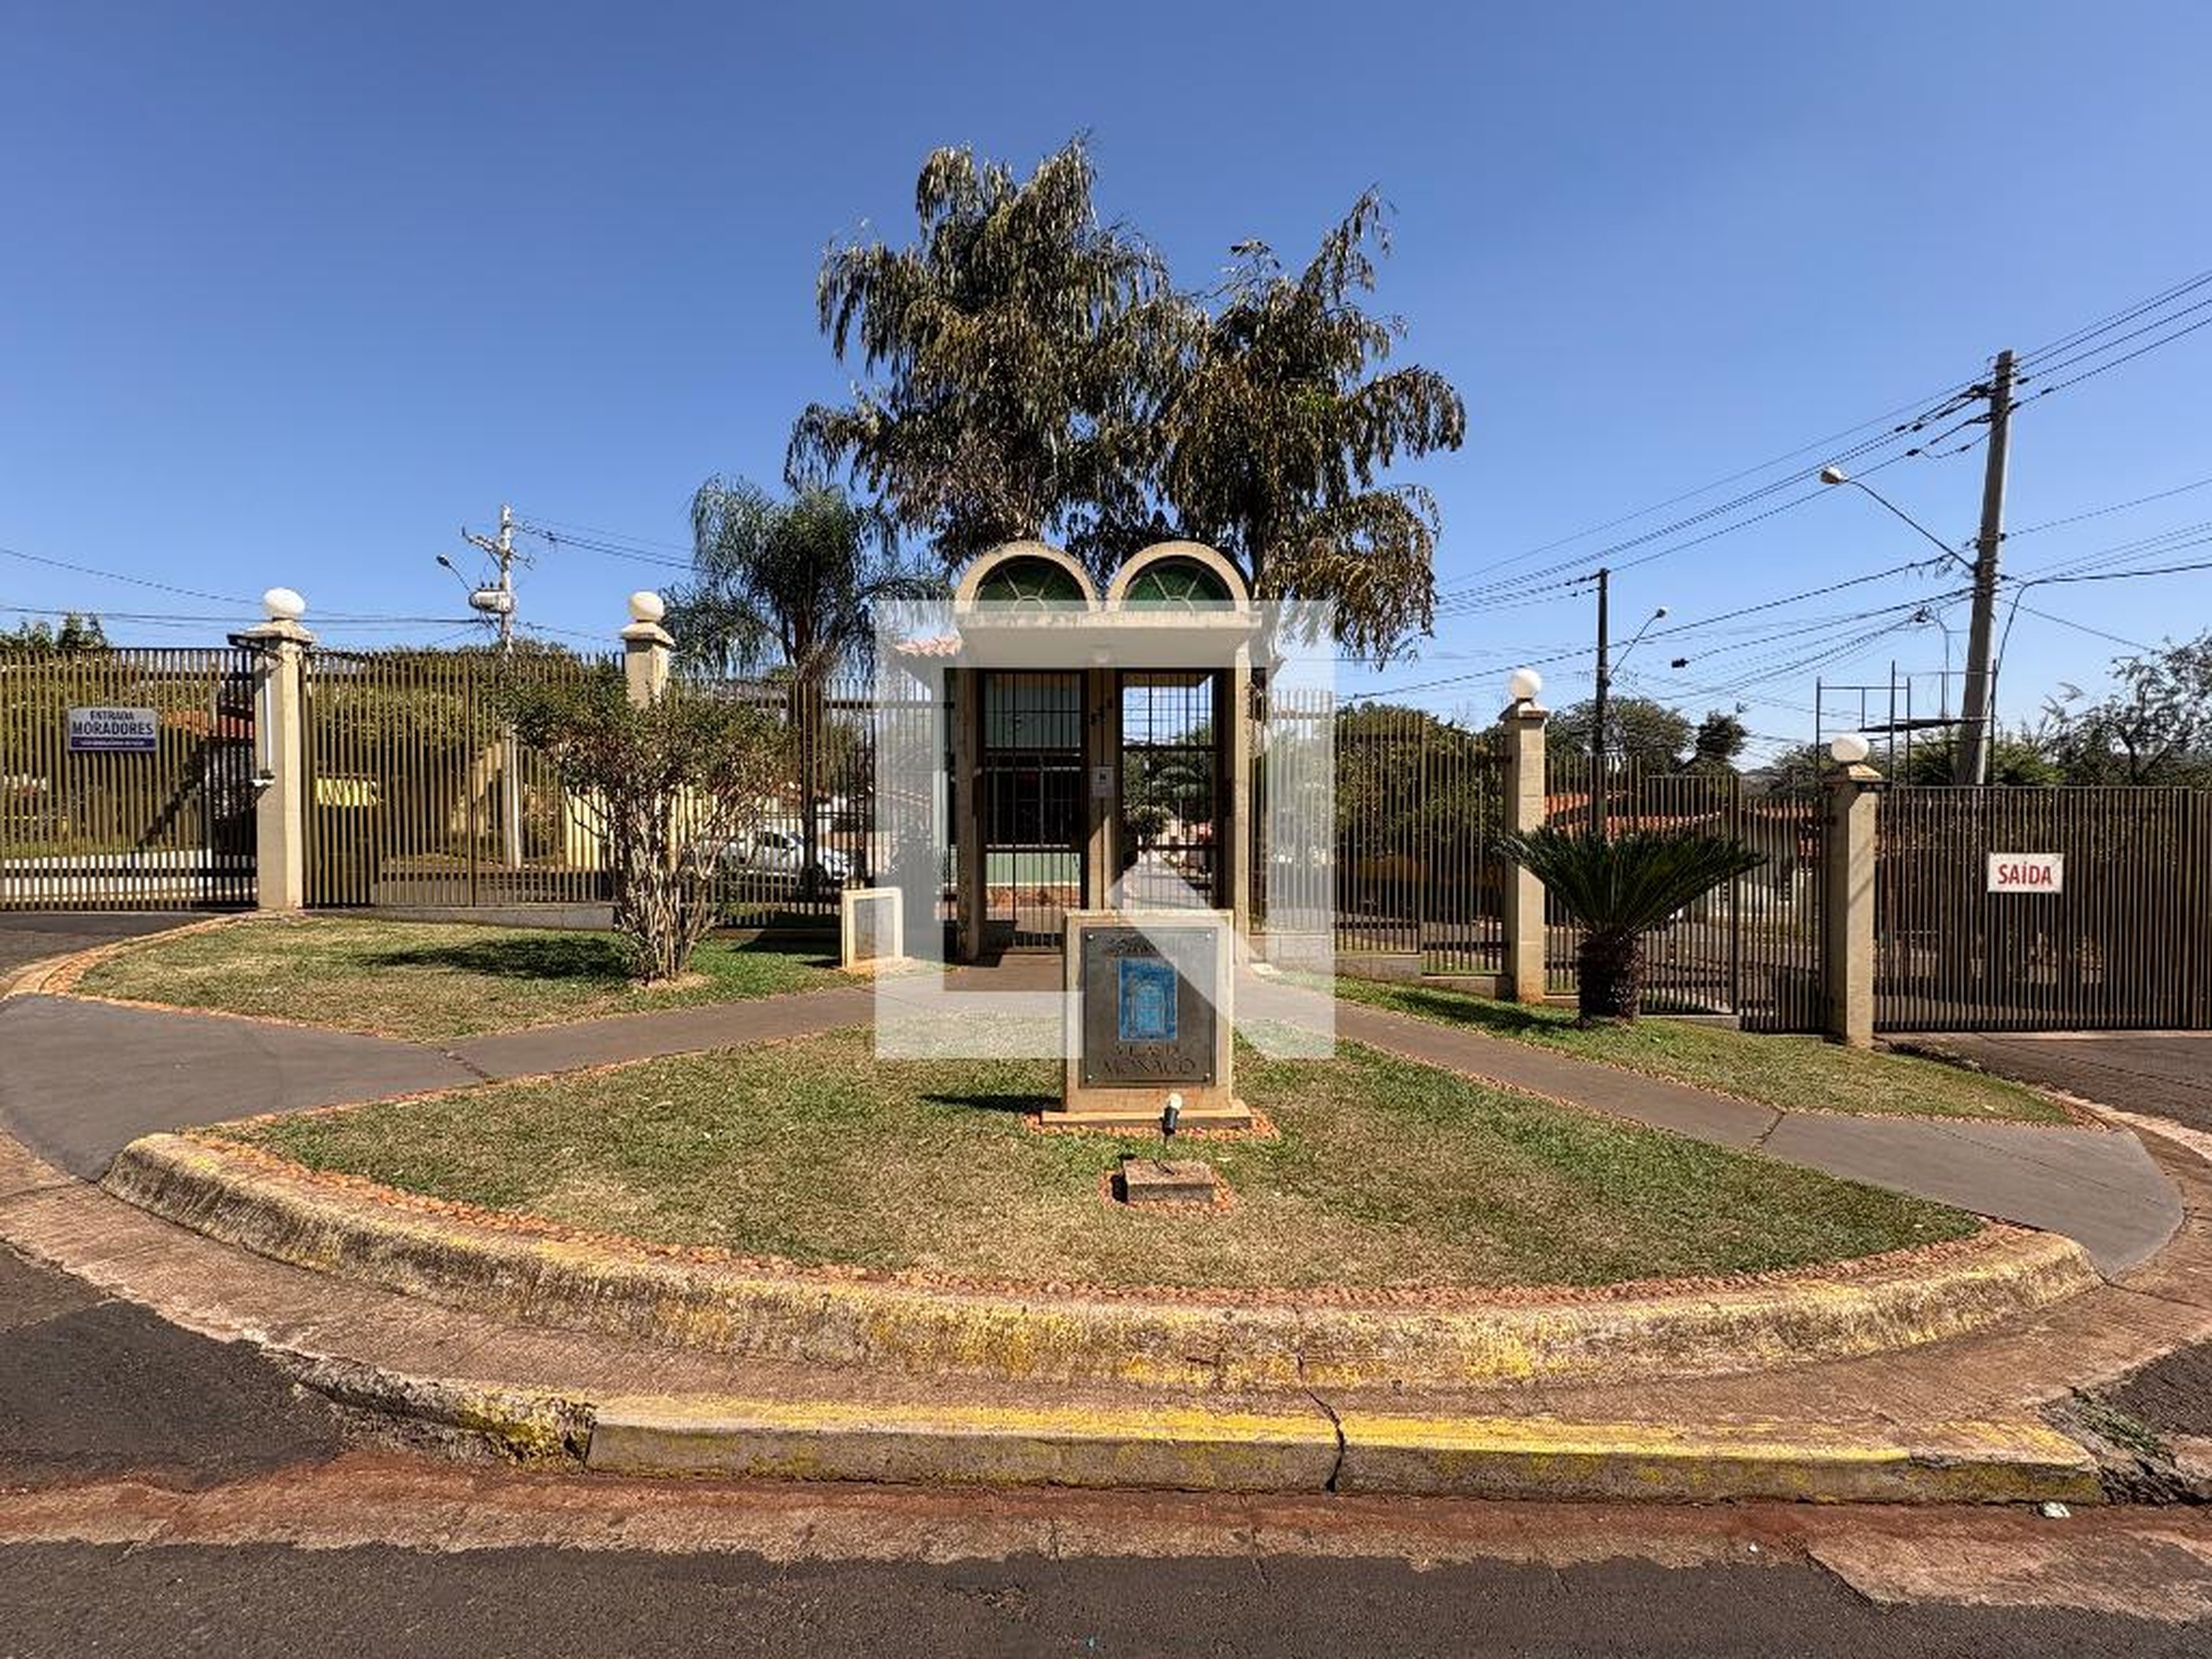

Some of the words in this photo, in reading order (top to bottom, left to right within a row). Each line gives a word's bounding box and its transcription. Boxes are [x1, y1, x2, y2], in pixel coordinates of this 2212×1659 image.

[90, 710, 134, 720] ENTRADA
[73, 721, 154, 735] MORADORES
[1998, 861, 2052, 884] SAÍDA
